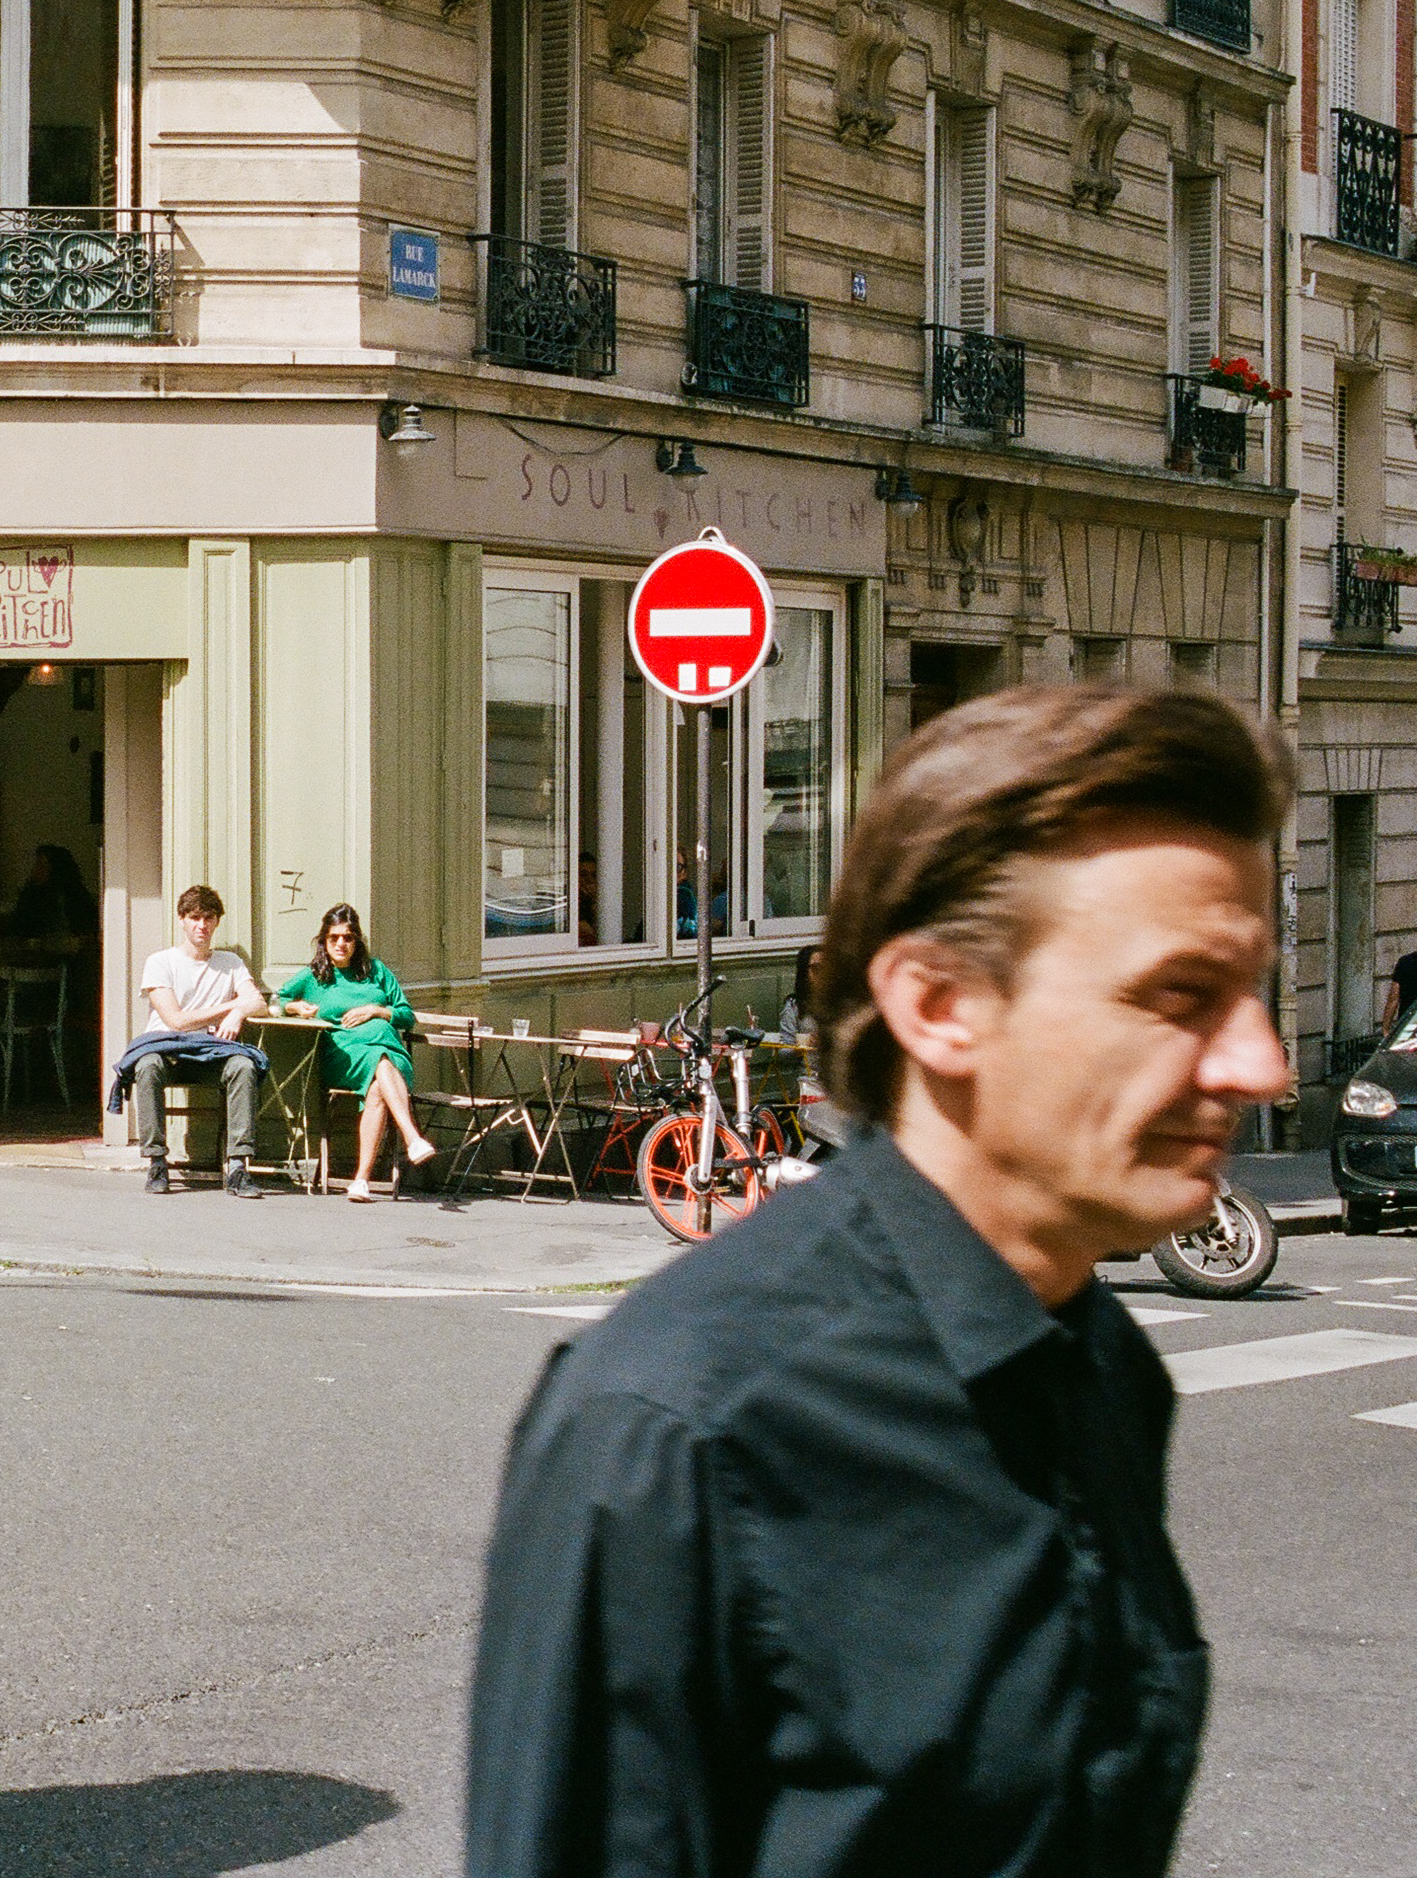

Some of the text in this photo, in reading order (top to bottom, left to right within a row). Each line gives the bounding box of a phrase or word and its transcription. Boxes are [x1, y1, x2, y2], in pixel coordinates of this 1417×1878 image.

[405, 244, 423, 262] RUE
[392, 266, 436, 288] LAMARCK
[521, 453, 634, 514] SOUL
